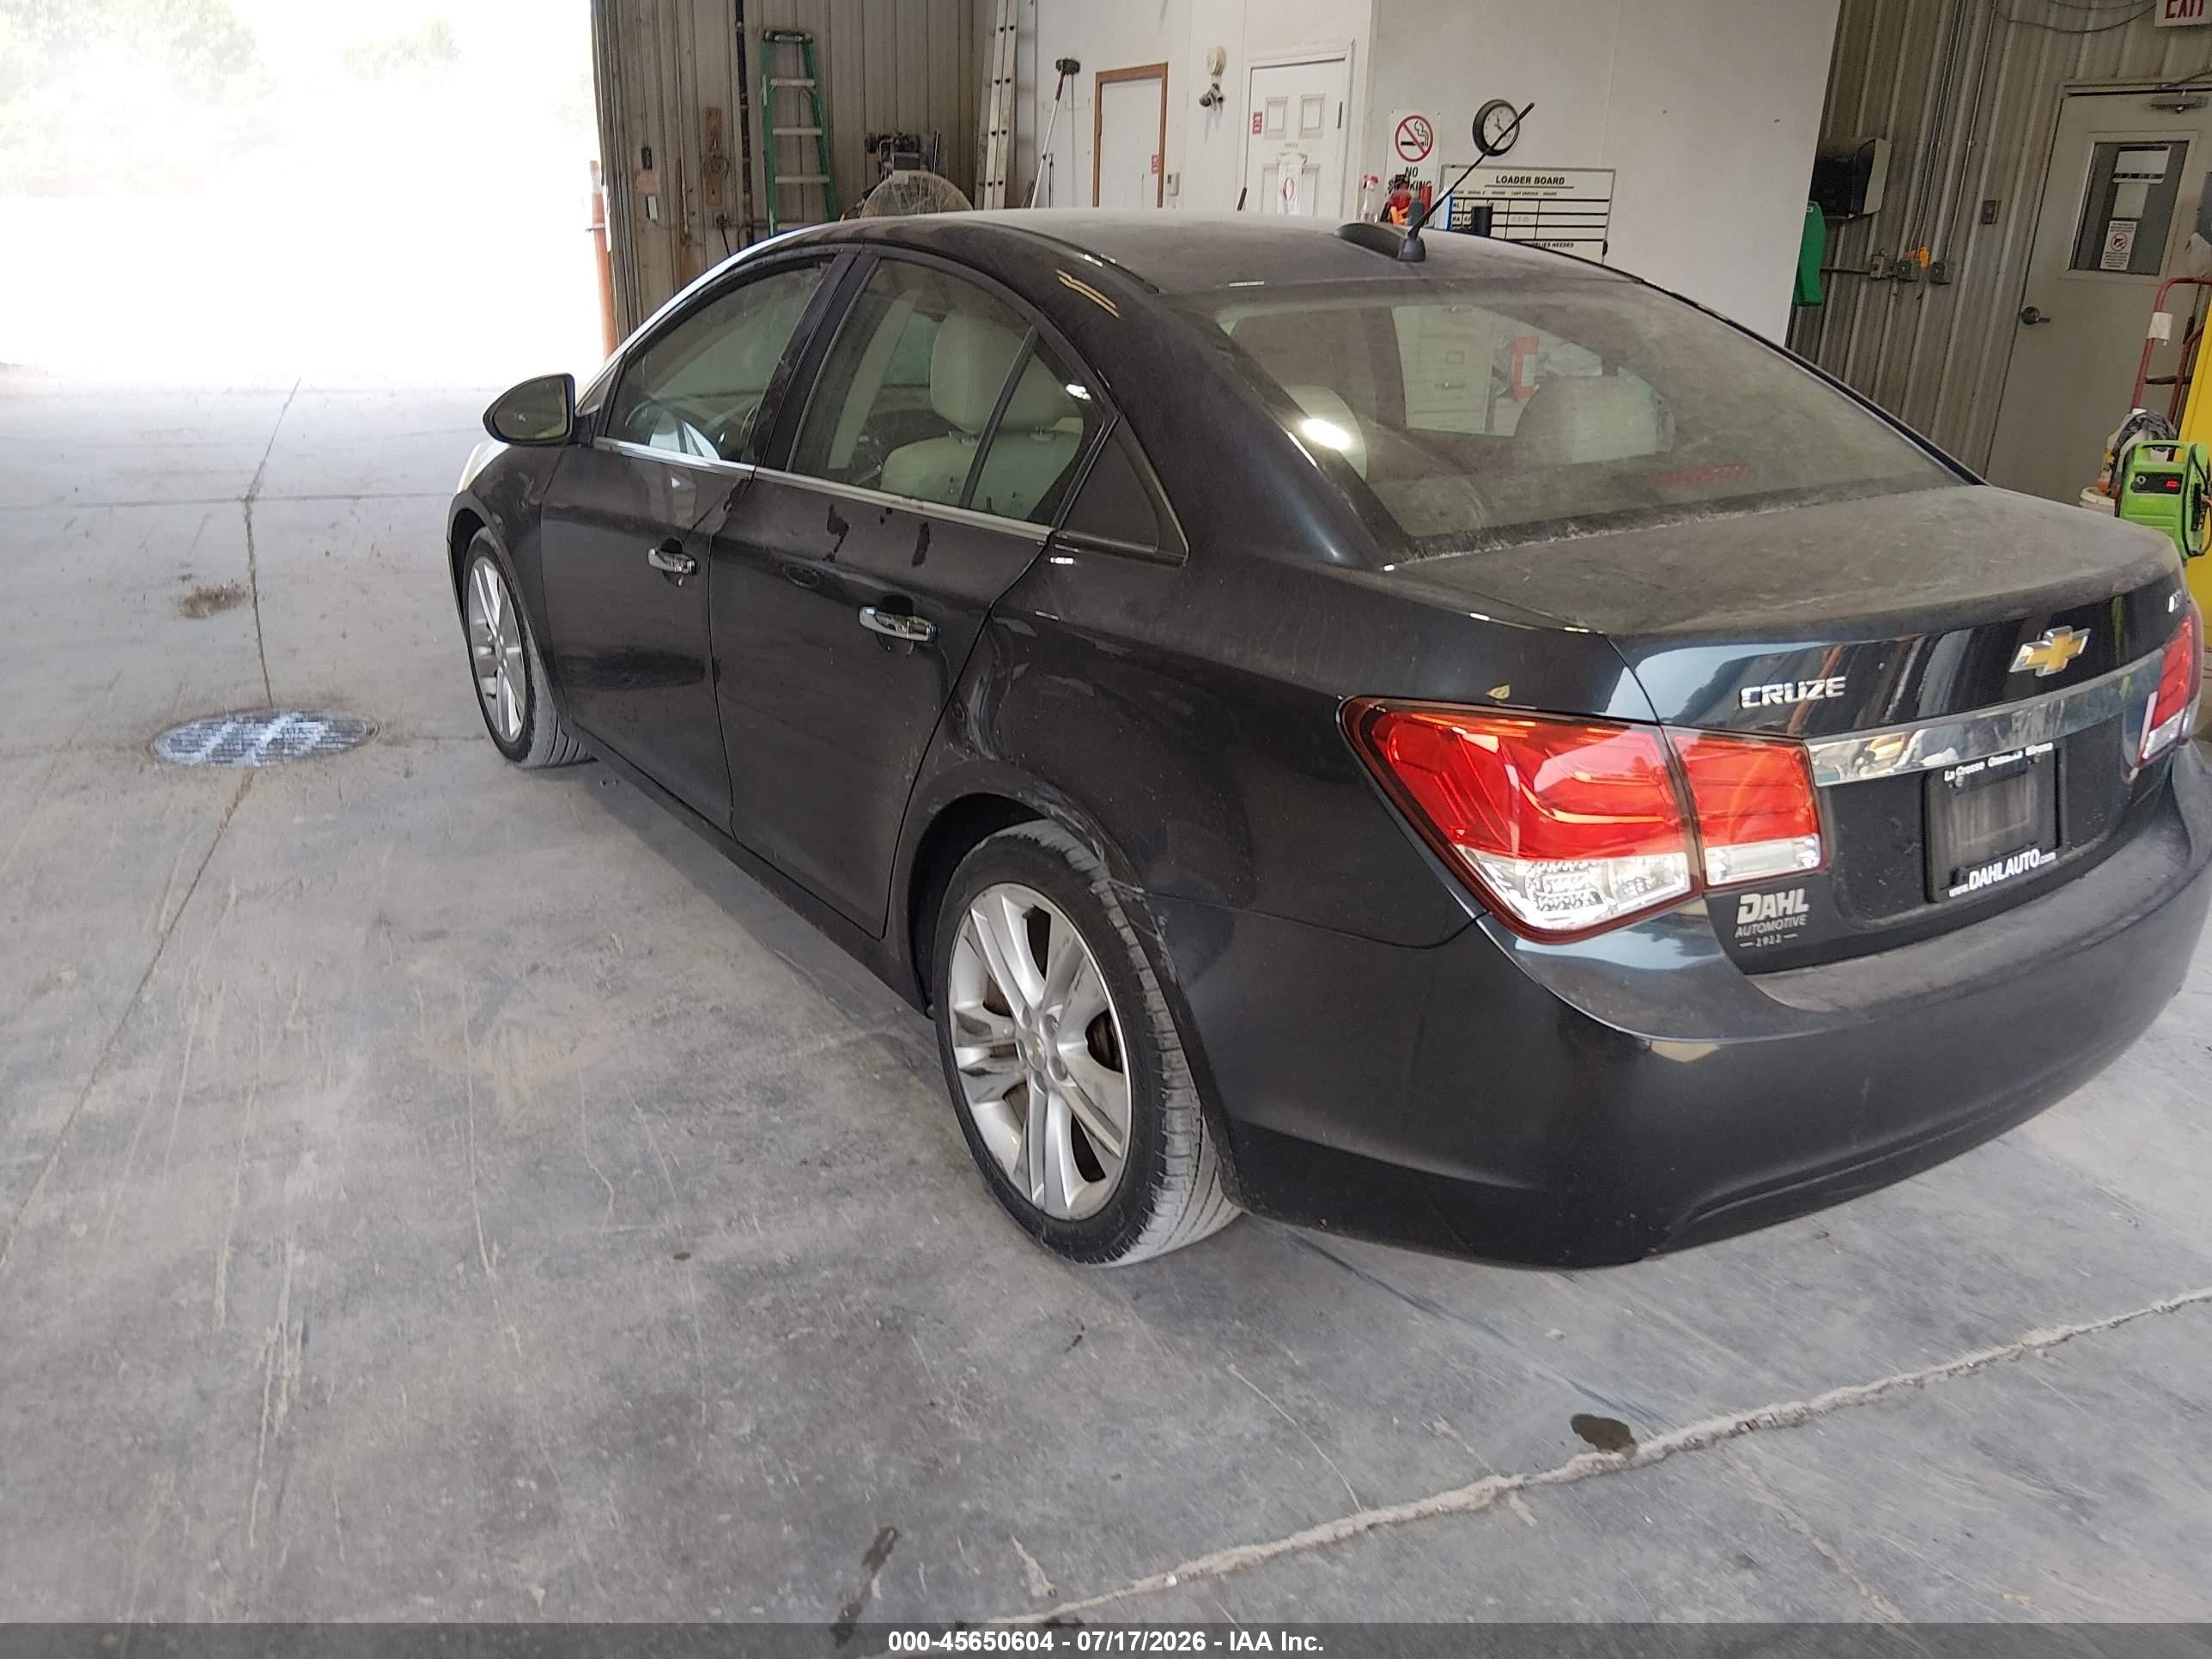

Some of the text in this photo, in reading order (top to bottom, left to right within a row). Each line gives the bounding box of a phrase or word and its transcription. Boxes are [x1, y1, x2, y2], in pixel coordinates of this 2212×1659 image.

[1404, 166, 1419, 178] NO
[1495, 175, 1565, 185] LOADER BOARD
[1740, 676, 1846, 708] CRUZE
[1736, 888, 1809, 925] DAHL
[1735, 914, 1807, 938] AUTOMOTIVE
